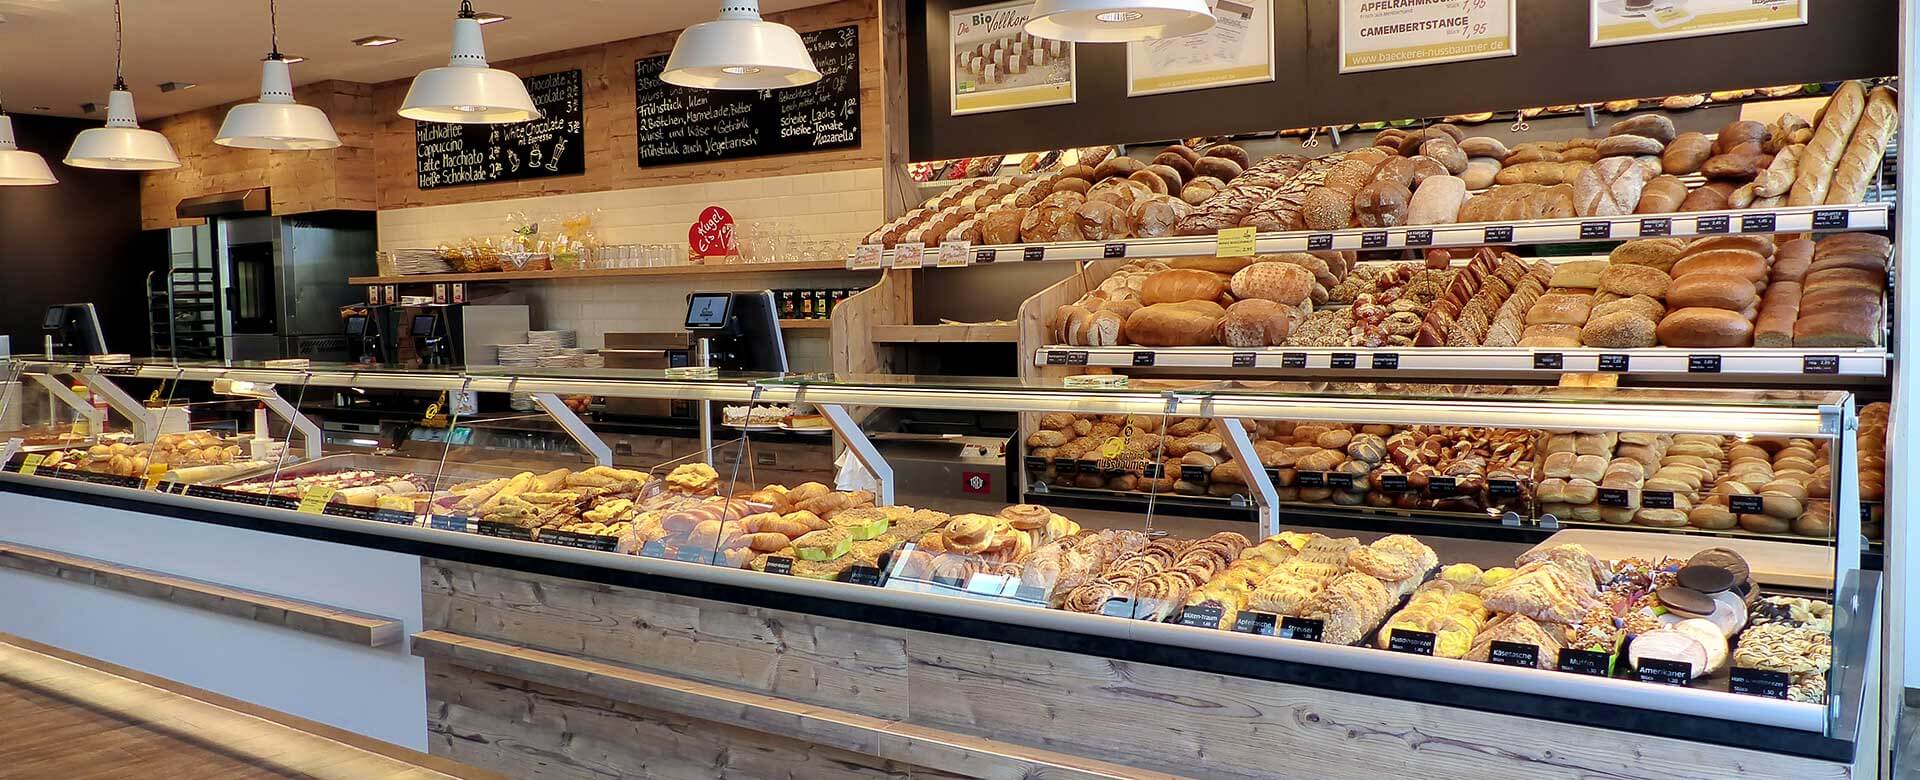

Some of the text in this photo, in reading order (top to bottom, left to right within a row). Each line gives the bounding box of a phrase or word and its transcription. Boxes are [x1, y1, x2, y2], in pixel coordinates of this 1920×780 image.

[958, 22, 969, 36] Die
[972, 14, 991, 26] Bio
[987, 10, 1029, 33] Vollkor
[1360, 16, 1469, 37] CAMEMBERTSTANGE
[1462, 23, 1487, 39] 1,95
[1352, 40, 1503, 65] www.baeckerei-nussbaumer.de
[529, 88, 564, 106] hocolate
[637, 97, 682, 117] Frühstück
[417, 124, 462, 142] Milchkaffee
[525, 115, 564, 136] Chocolate
[418, 139, 463, 157] Cappuccino
[640, 141, 680, 159] Frühstück
[682, 140, 702, 154] auch
[419, 158, 440, 173] Latte
[442, 148, 484, 168] Macchiato
[442, 165, 486, 184] Schokolade
[698, 209, 723, 236] Kugel
[699, 234, 715, 252] Eis
[1639, 666, 1686, 678] Amerikaner
